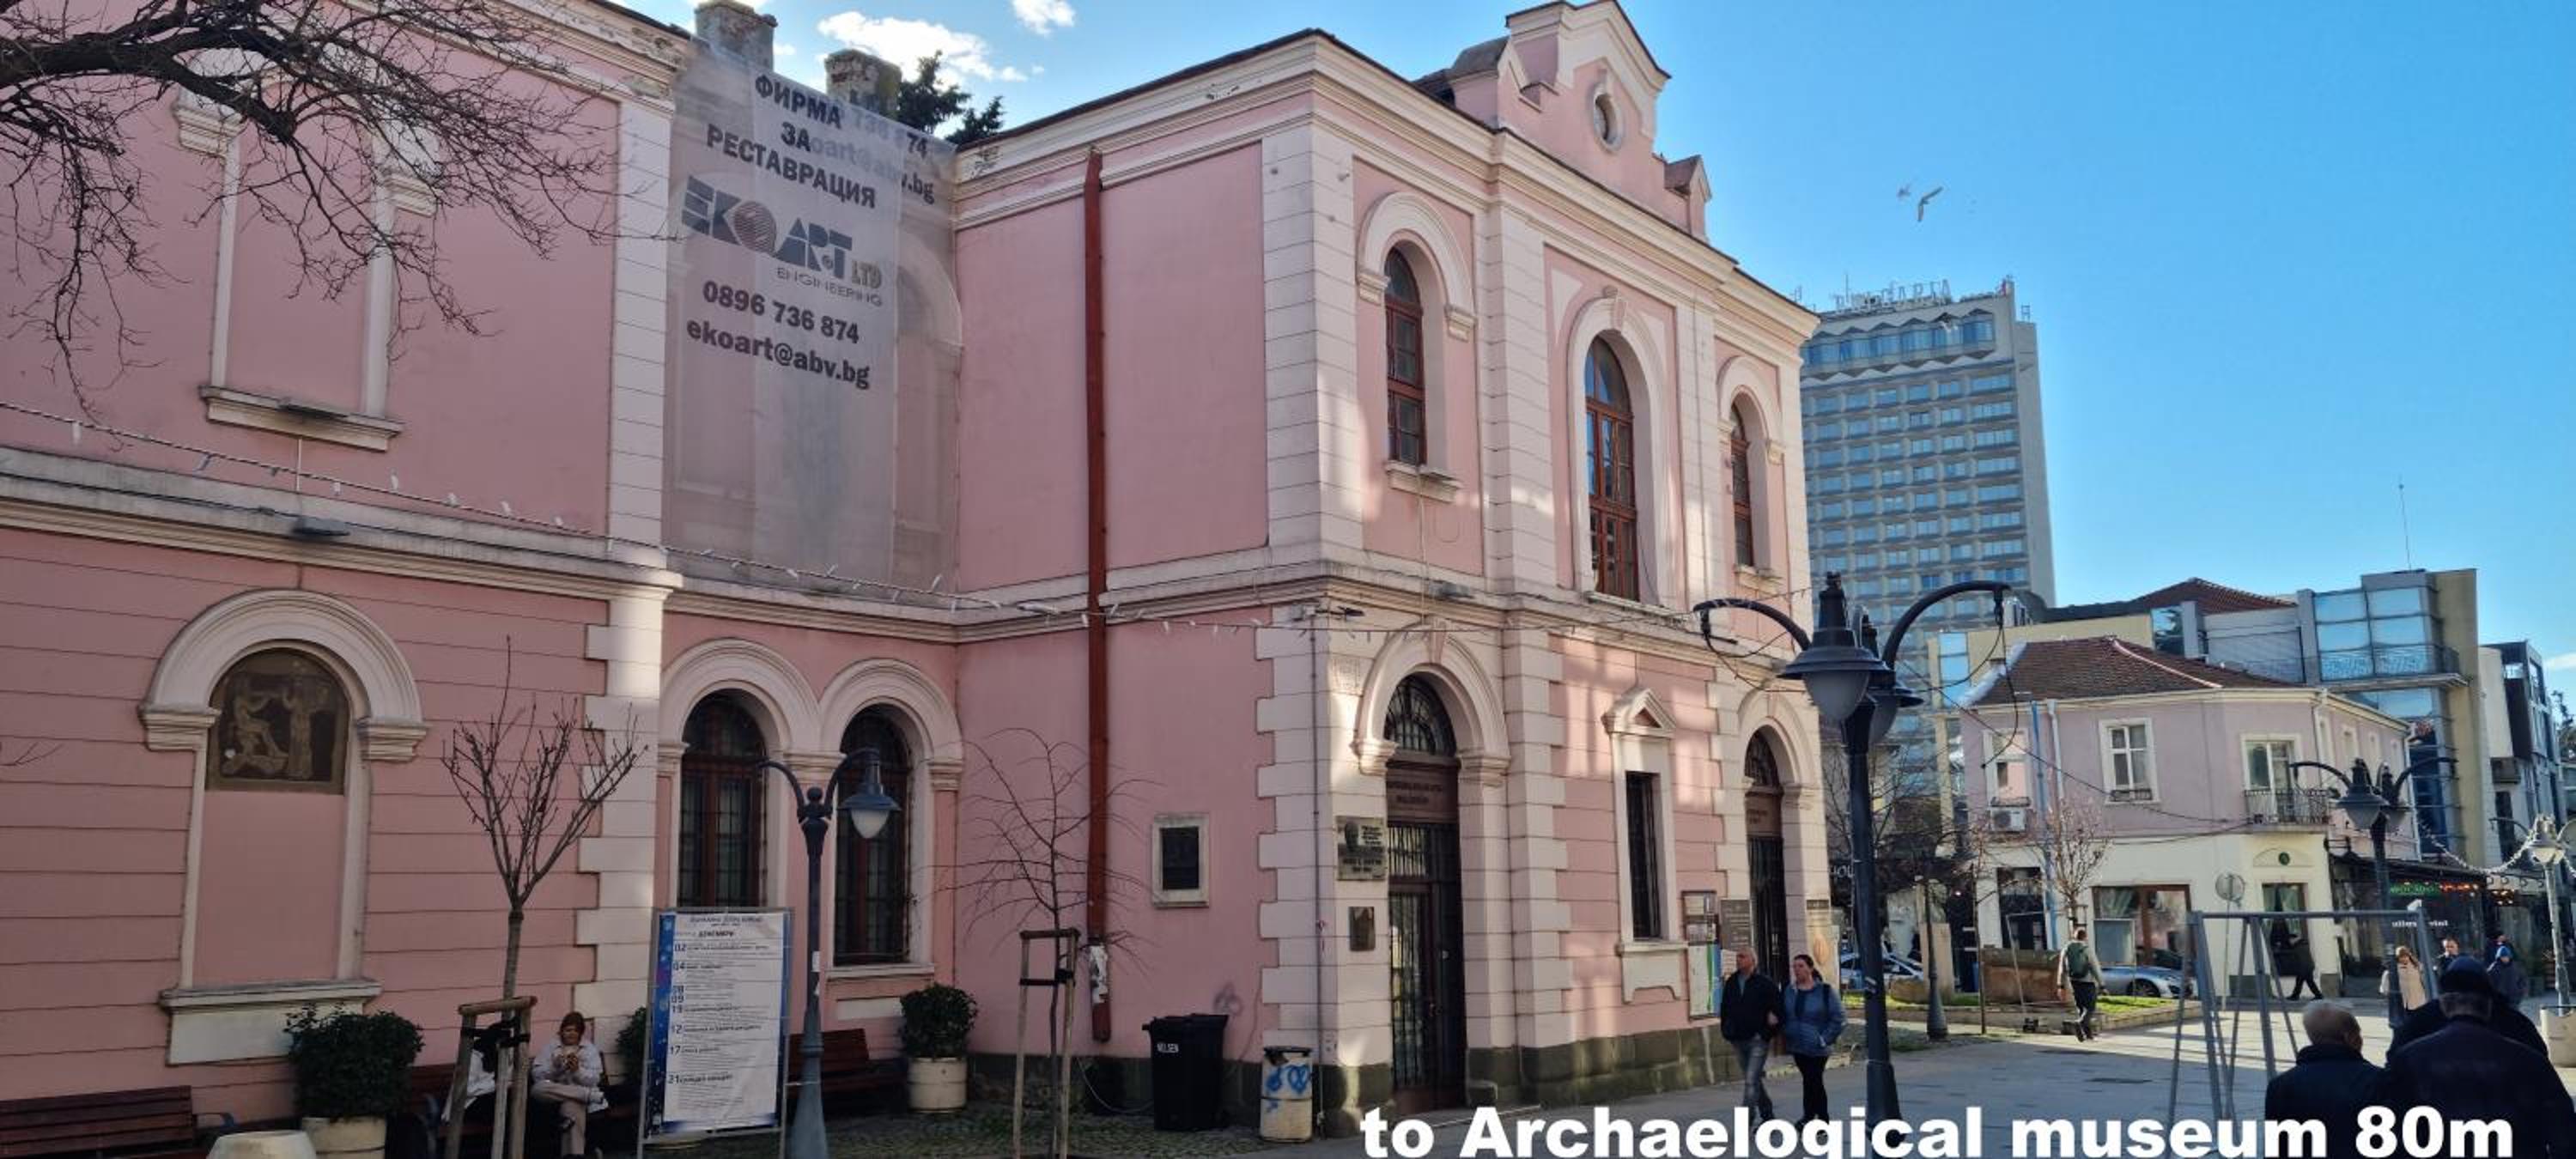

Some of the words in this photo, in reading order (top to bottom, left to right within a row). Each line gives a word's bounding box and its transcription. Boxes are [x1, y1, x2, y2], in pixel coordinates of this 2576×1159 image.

[754, 75, 842, 129] ФИРМА
[781, 121, 811, 152] ЗА
[707, 124, 876, 209] РЕСТАВРАЦИЯ
[775, 267, 884, 307] ENGINEERING
[850, 260, 883, 290] LTD
[702, 280, 766, 317] 0896
[773, 300, 815, 332] 736
[820, 315, 860, 345] 874
[686, 317, 871, 391] ekoart@abv.bg
